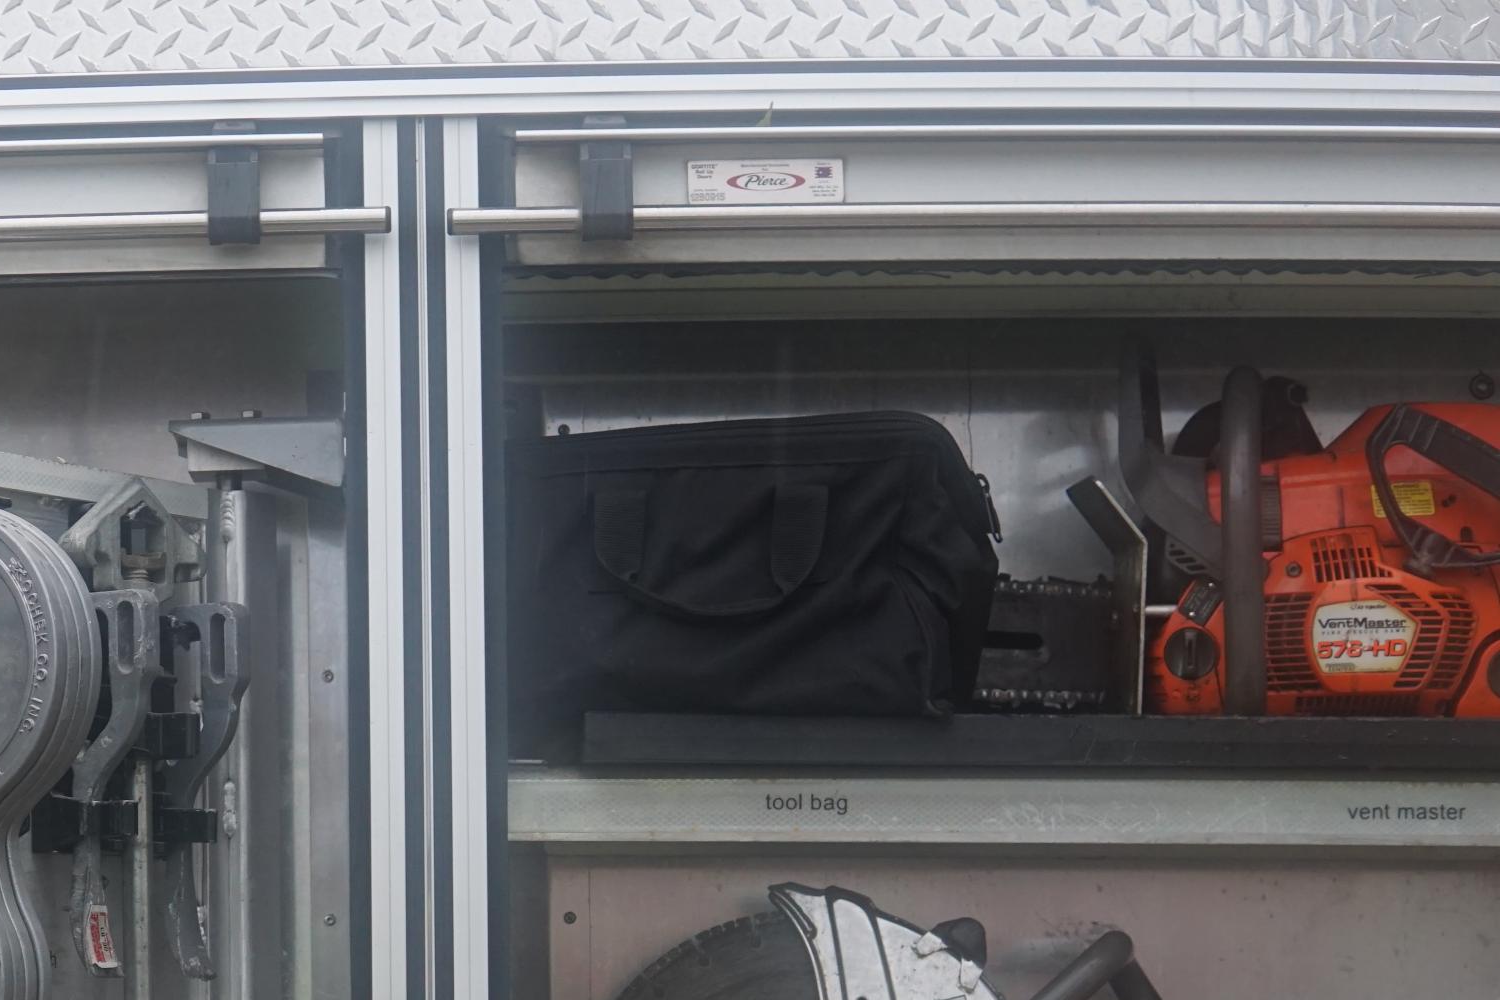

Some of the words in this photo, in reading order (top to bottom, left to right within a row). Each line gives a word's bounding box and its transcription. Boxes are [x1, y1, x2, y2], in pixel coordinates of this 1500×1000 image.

[745, 174, 787, 188] Pierce
[1318, 617, 1407, 629] VentMaster
[765, 793, 803, 810] tool
[810, 793, 848, 815] bag
[1347, 804, 1390, 820] vent
[1397, 804, 1466, 820] master
